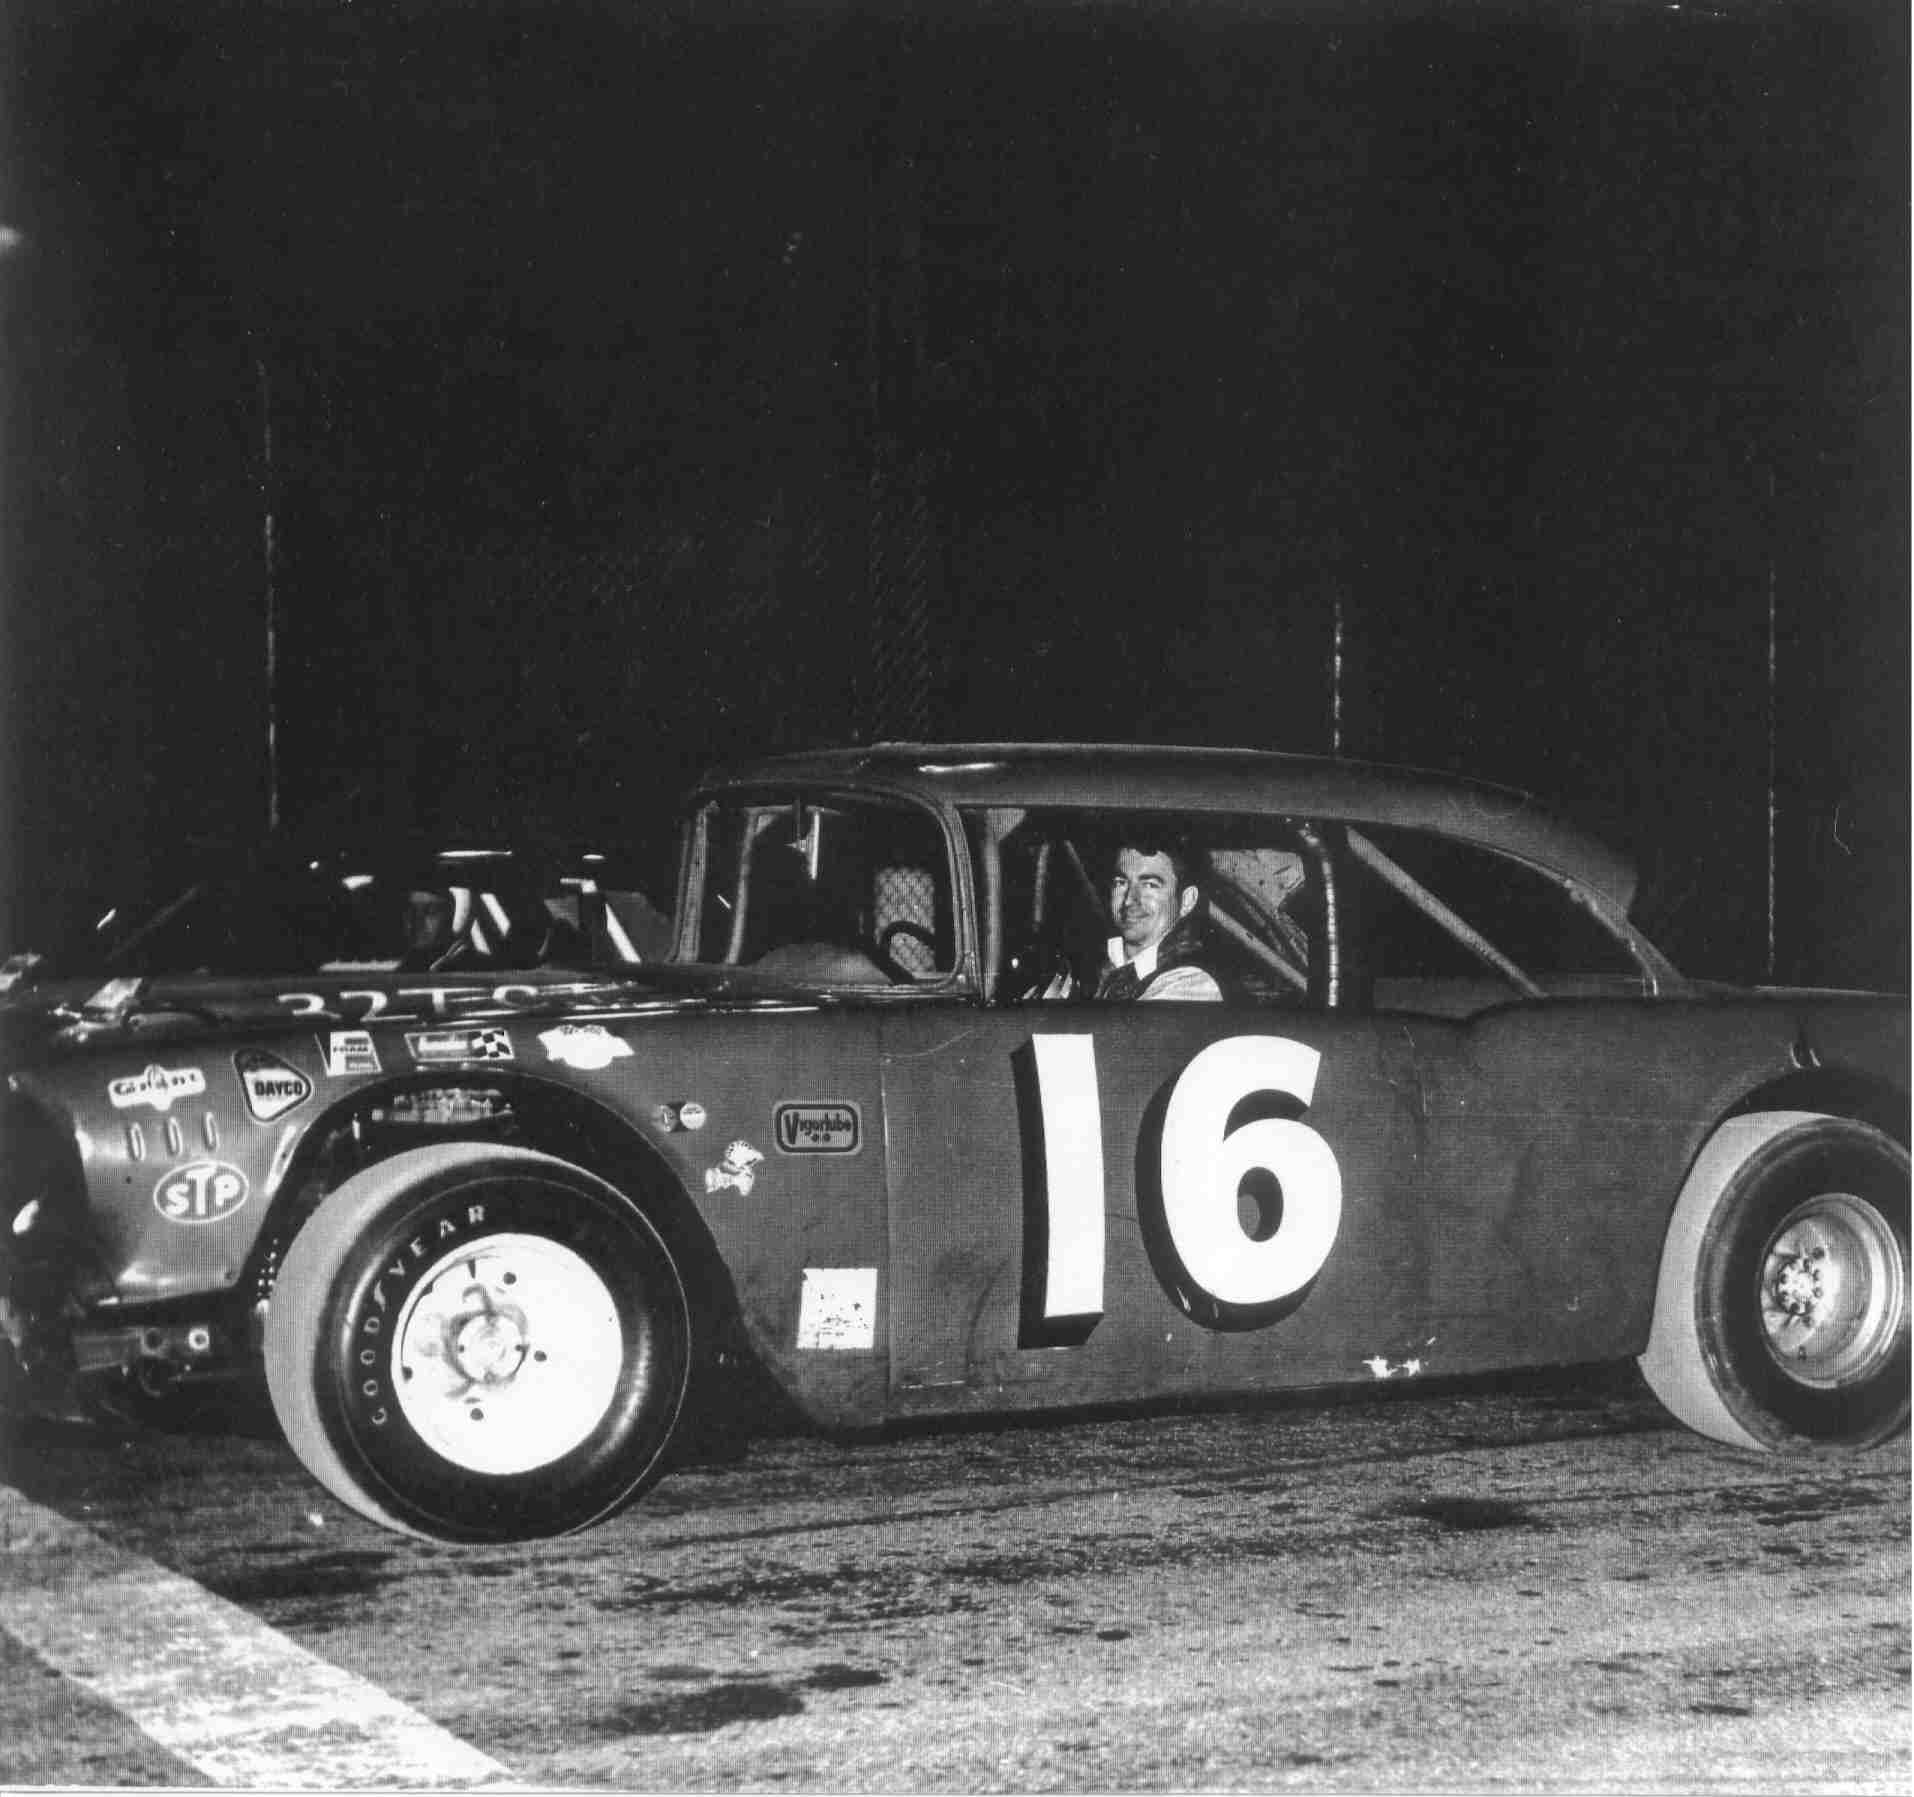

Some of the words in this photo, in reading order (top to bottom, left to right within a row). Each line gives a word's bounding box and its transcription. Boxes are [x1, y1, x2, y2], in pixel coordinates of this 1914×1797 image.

[254, 1079, 303, 1097] DAYCO
[165, 1165, 241, 1216] STP
[1030, 1033, 1342, 1319] 16
[359, 1205, 485, 1425] GOODYEAR
